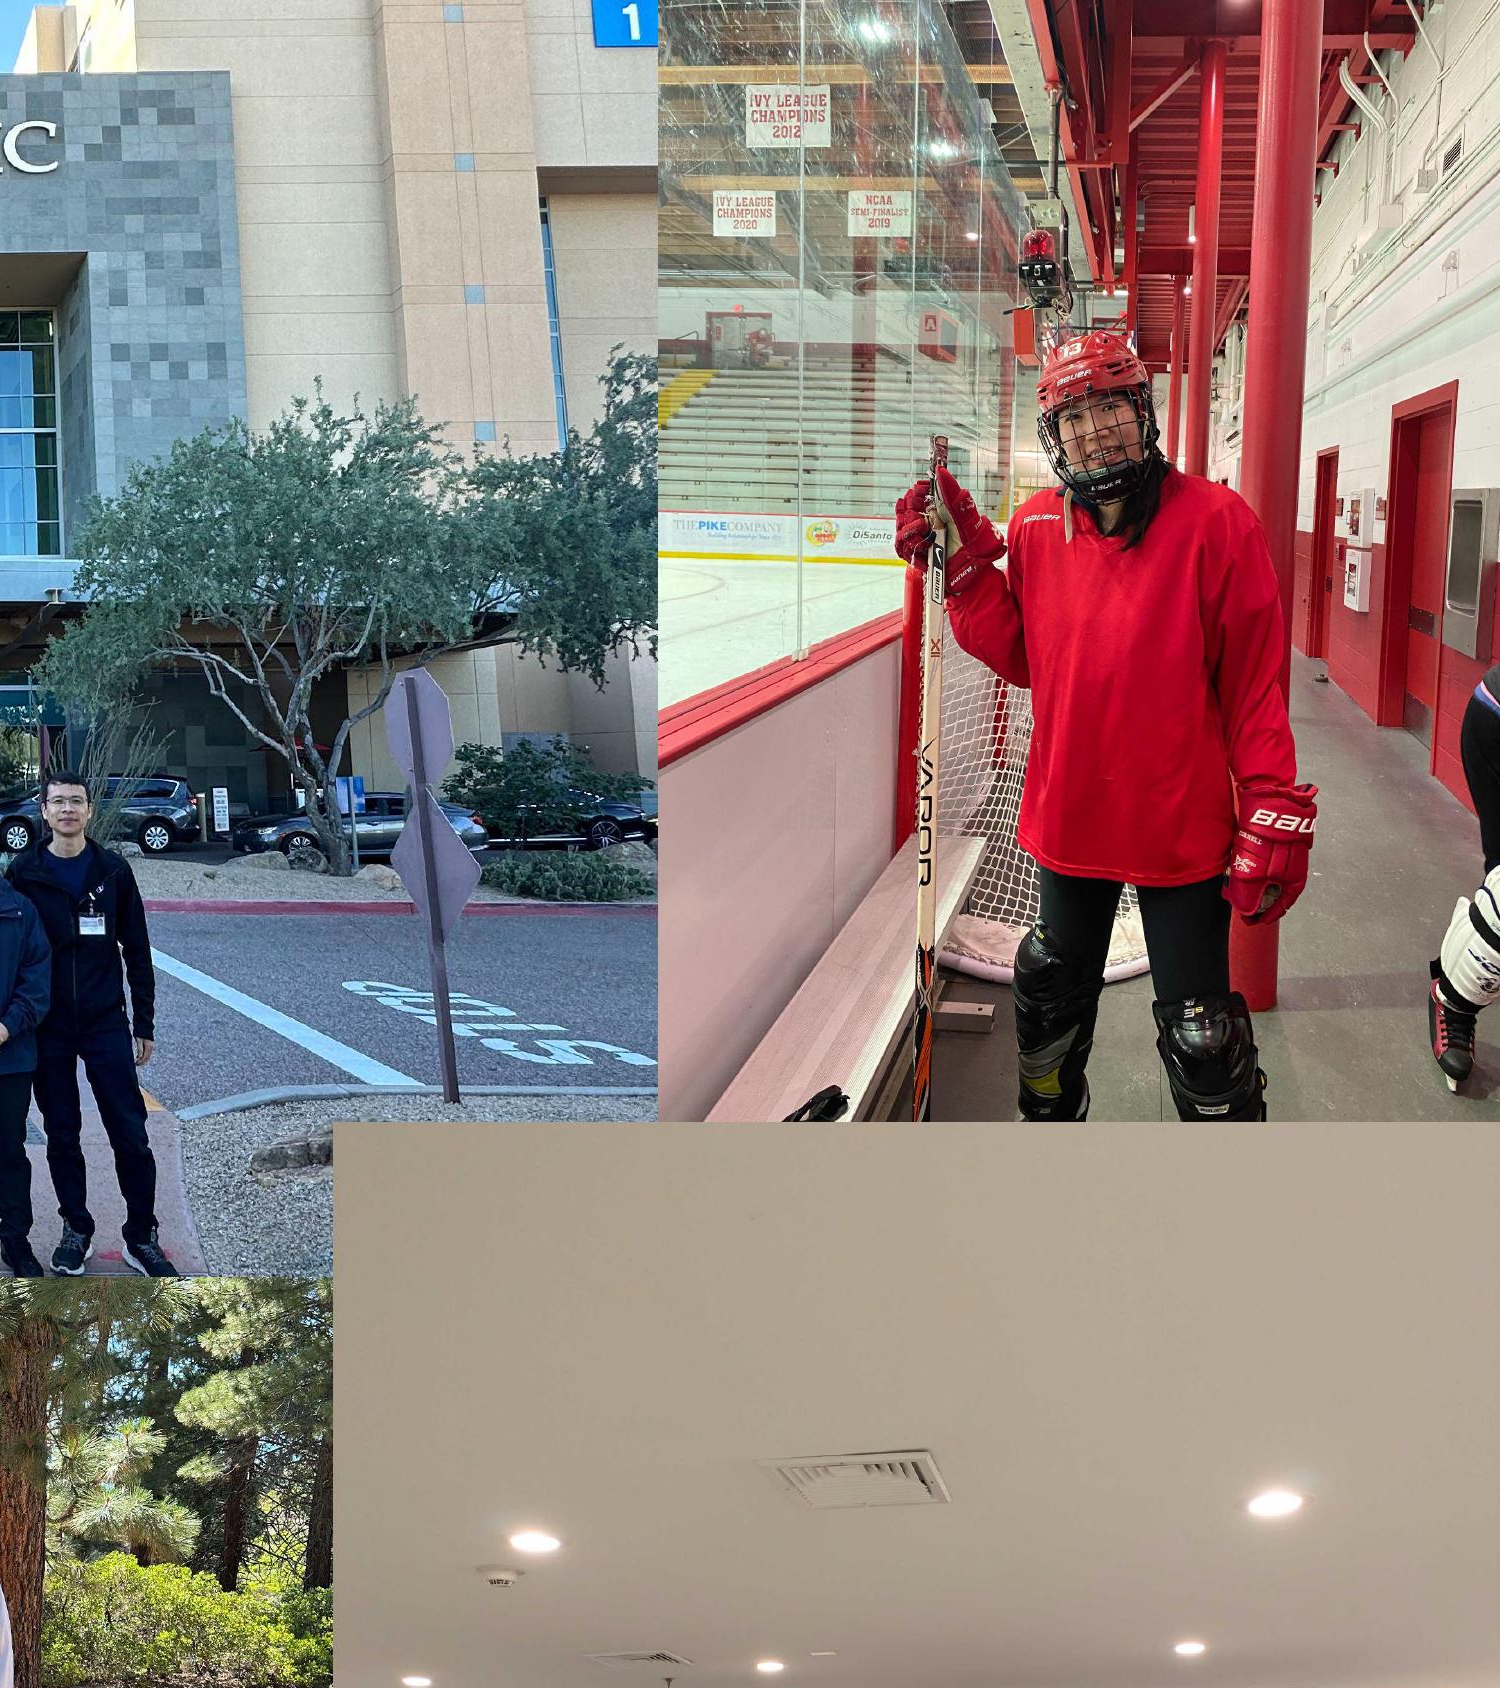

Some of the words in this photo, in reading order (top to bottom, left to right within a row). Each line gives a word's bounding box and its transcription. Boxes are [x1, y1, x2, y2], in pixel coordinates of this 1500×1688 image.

[750, 95, 771, 107] IVY
[776, 94, 827, 107] LEAGUE
[751, 110, 825, 123] CHAMPIONS
[772, 125, 801, 138] 2012
[716, 197, 732, 206] IVY
[736, 196, 773, 207] LEAGUE
[865, 195, 892, 205] NCAA
[717, 209, 772, 218] CHAMPIONS
[851, 208, 909, 216] SEMI-FINALIST
[733, 219, 757, 229] 2020
[868, 218, 890, 228] 2019
[1062, 343, 1082, 358] 13
[673, 519, 699, 530] THE
[698, 521, 727, 531] PIKE
[727, 521, 783, 533] COMPANY
[933, 569, 941, 601] BAUER
[918, 737, 937, 888] VAPOR
